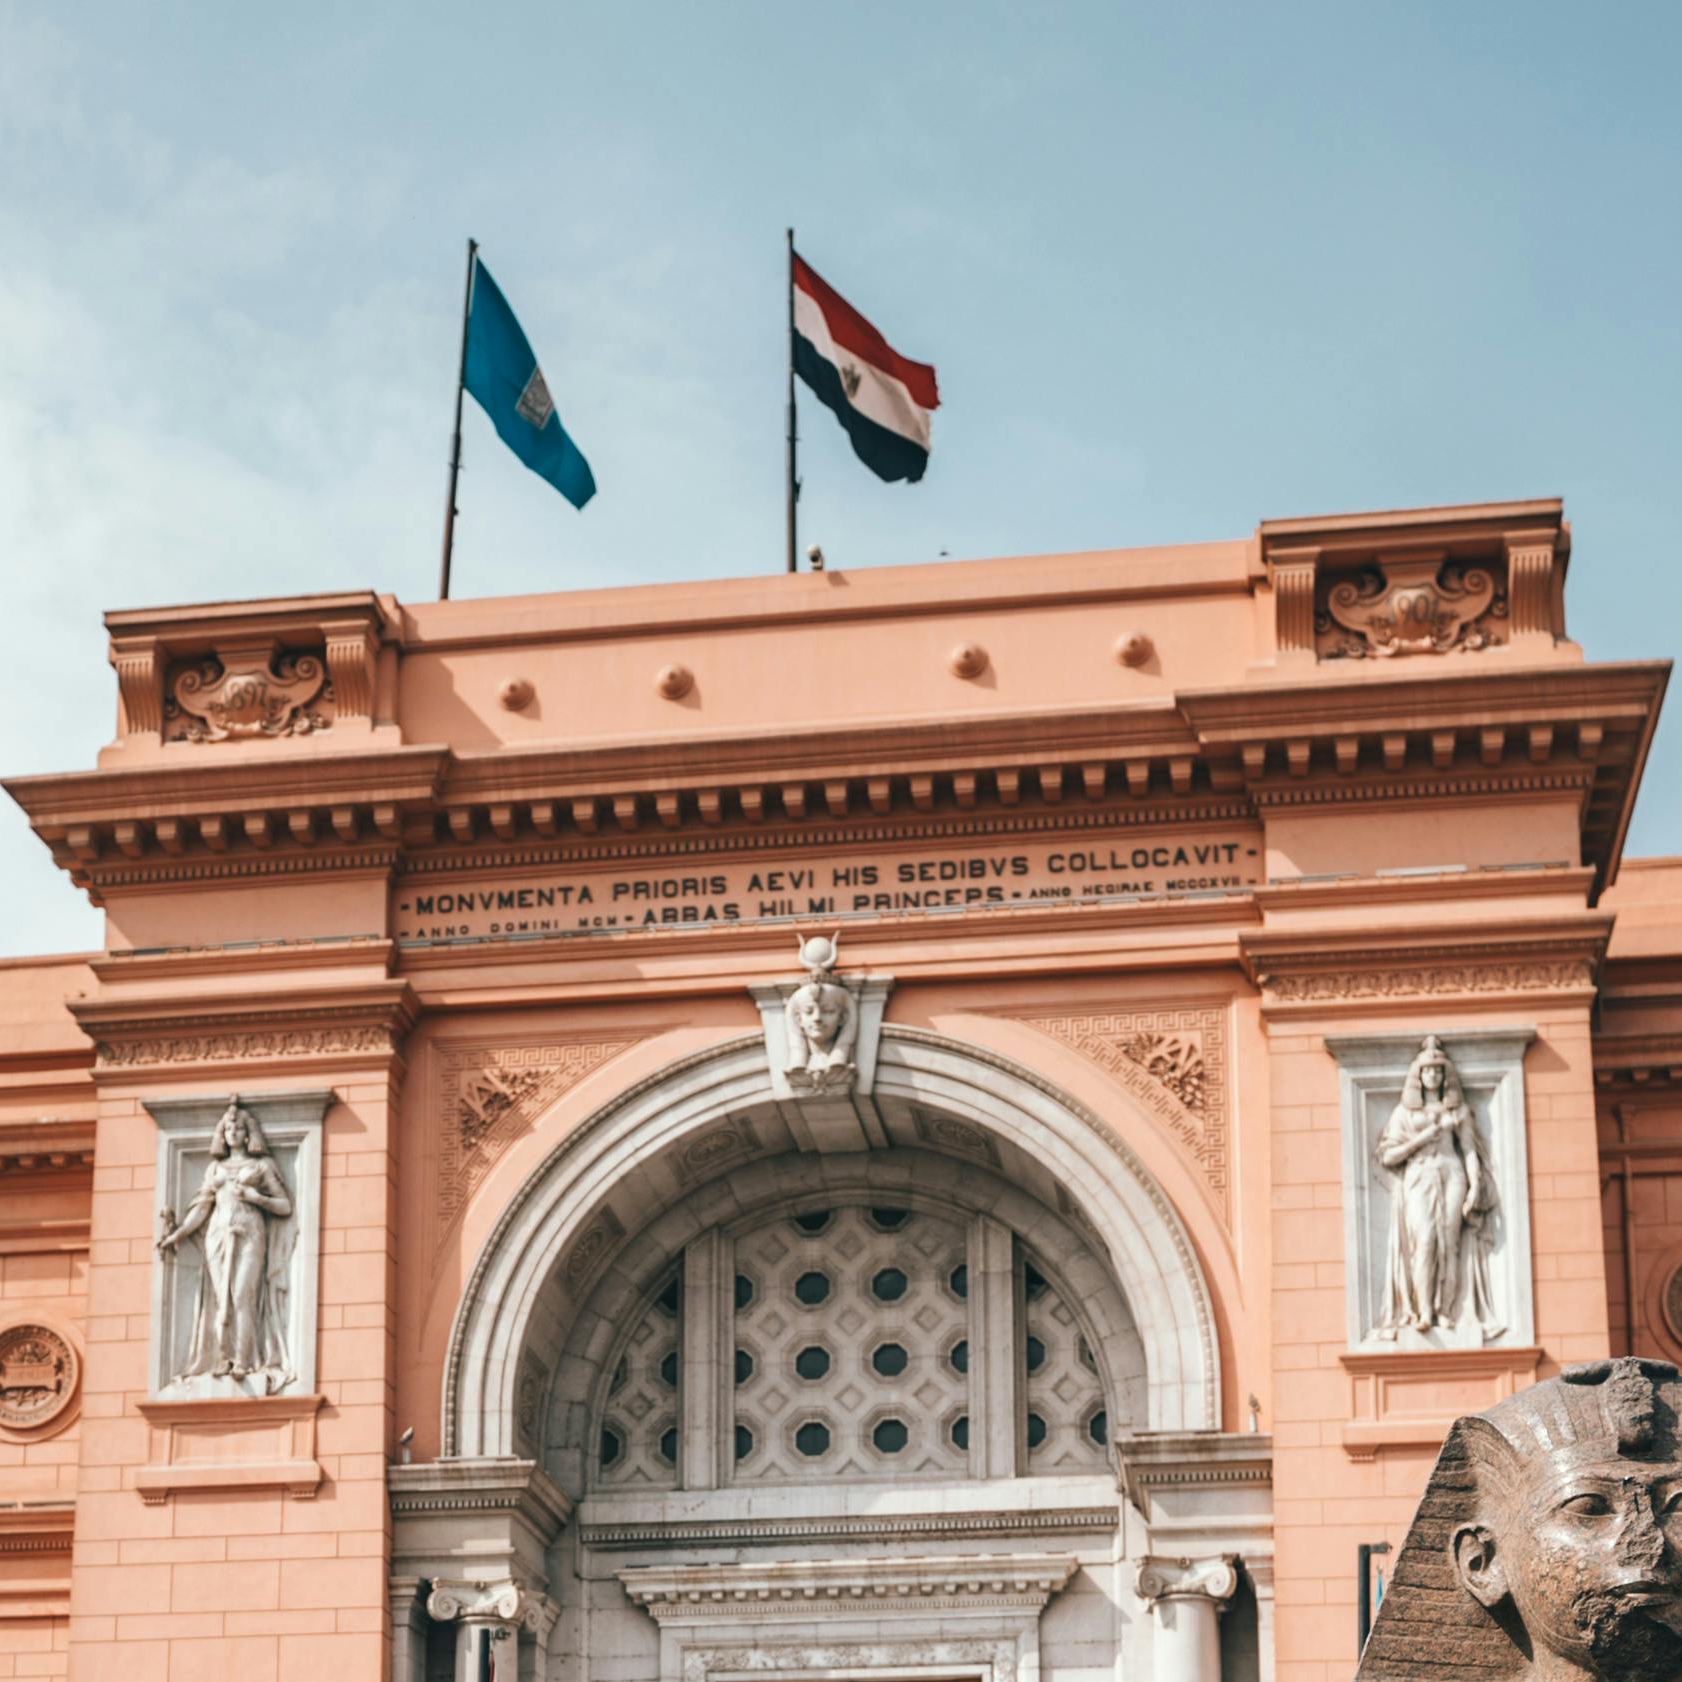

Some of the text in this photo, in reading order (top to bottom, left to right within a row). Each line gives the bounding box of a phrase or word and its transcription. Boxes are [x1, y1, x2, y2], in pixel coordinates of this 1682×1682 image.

[416, 843, 1240, 915] MONVMENTA PRIORIS AEVI HIS SEDIBVS COLLOCAVIT
[416, 924, 470, 940] ANNO
[490, 919, 559, 934] DOMINI
[579, 916, 617, 928] MCM
[643, 903, 740, 926] ABBAS
[758, 896, 834, 918] HILMI
[853, 886, 1003, 912] PRINCEPS
[1029, 885, 1072, 900] ANNO
[1082, 880, 1154, 896] HEGIRAE
